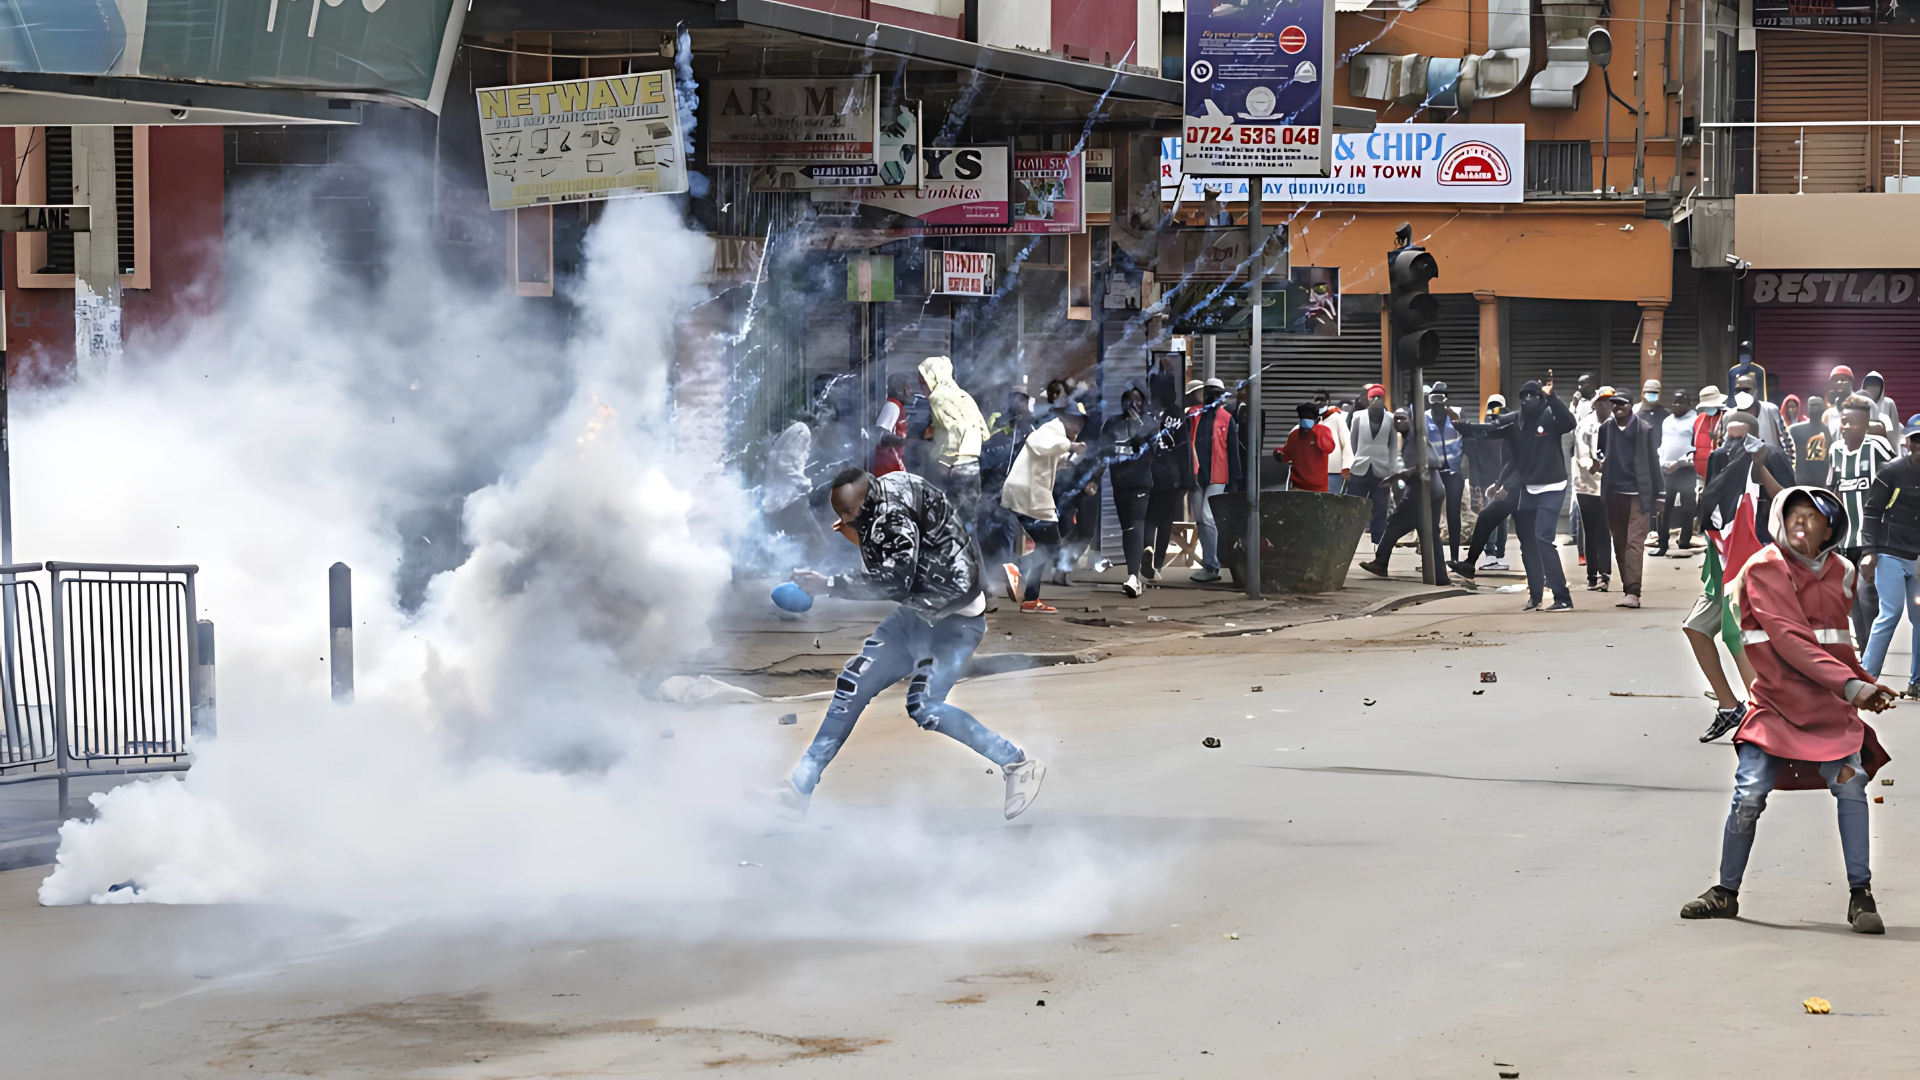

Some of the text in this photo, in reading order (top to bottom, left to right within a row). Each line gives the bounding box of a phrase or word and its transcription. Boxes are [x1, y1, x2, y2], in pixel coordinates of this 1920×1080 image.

[481, 75, 665, 119] NETWAVE
[1187, 126, 1319, 145] 0724 536 048
[1335, 134, 1356, 161] &
[1366, 132, 1447, 161] CHIPS
[1350, 165, 1366, 178] IN
[1372, 165, 1422, 178] TOWN
[915, 185, 982, 200] Cookies
[1192, 183, 1233, 194] TE
[1238, 183, 1283, 194] AAY
[25, 208, 70, 229] LANE
